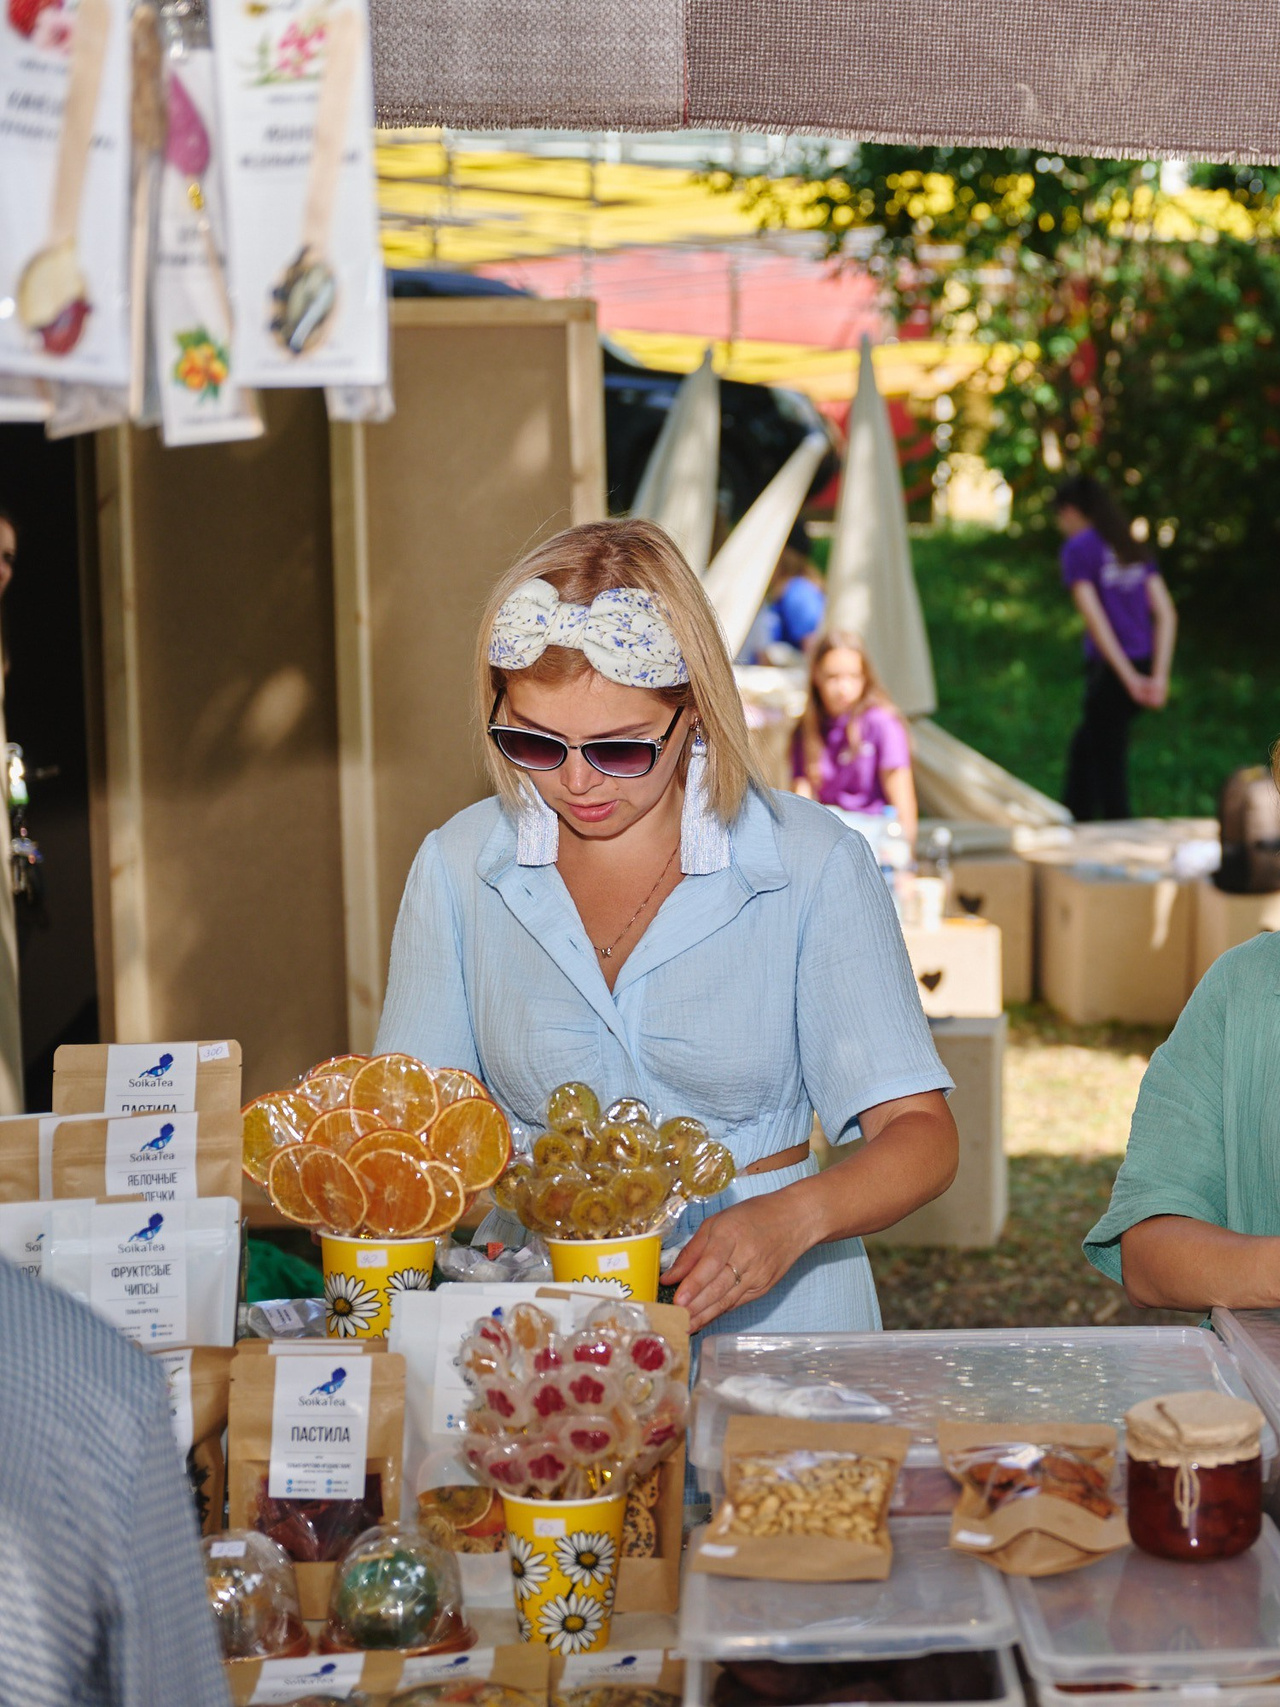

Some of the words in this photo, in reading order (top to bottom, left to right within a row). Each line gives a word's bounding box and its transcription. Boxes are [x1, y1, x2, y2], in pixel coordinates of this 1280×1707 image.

[128, 1077, 174, 1088] SoikaTea
[129, 1151, 175, 1163] SoikaTea
[127, 1172, 178, 1187] ЯБЛОЧНЫЕ
[117, 1242, 165, 1254] SoikaTea
[124, 1283, 159, 1296] ЧИПСЫ
[298, 1396, 346, 1407] SoikaTea
[290, 1425, 351, 1443] ПАСТИЛА
